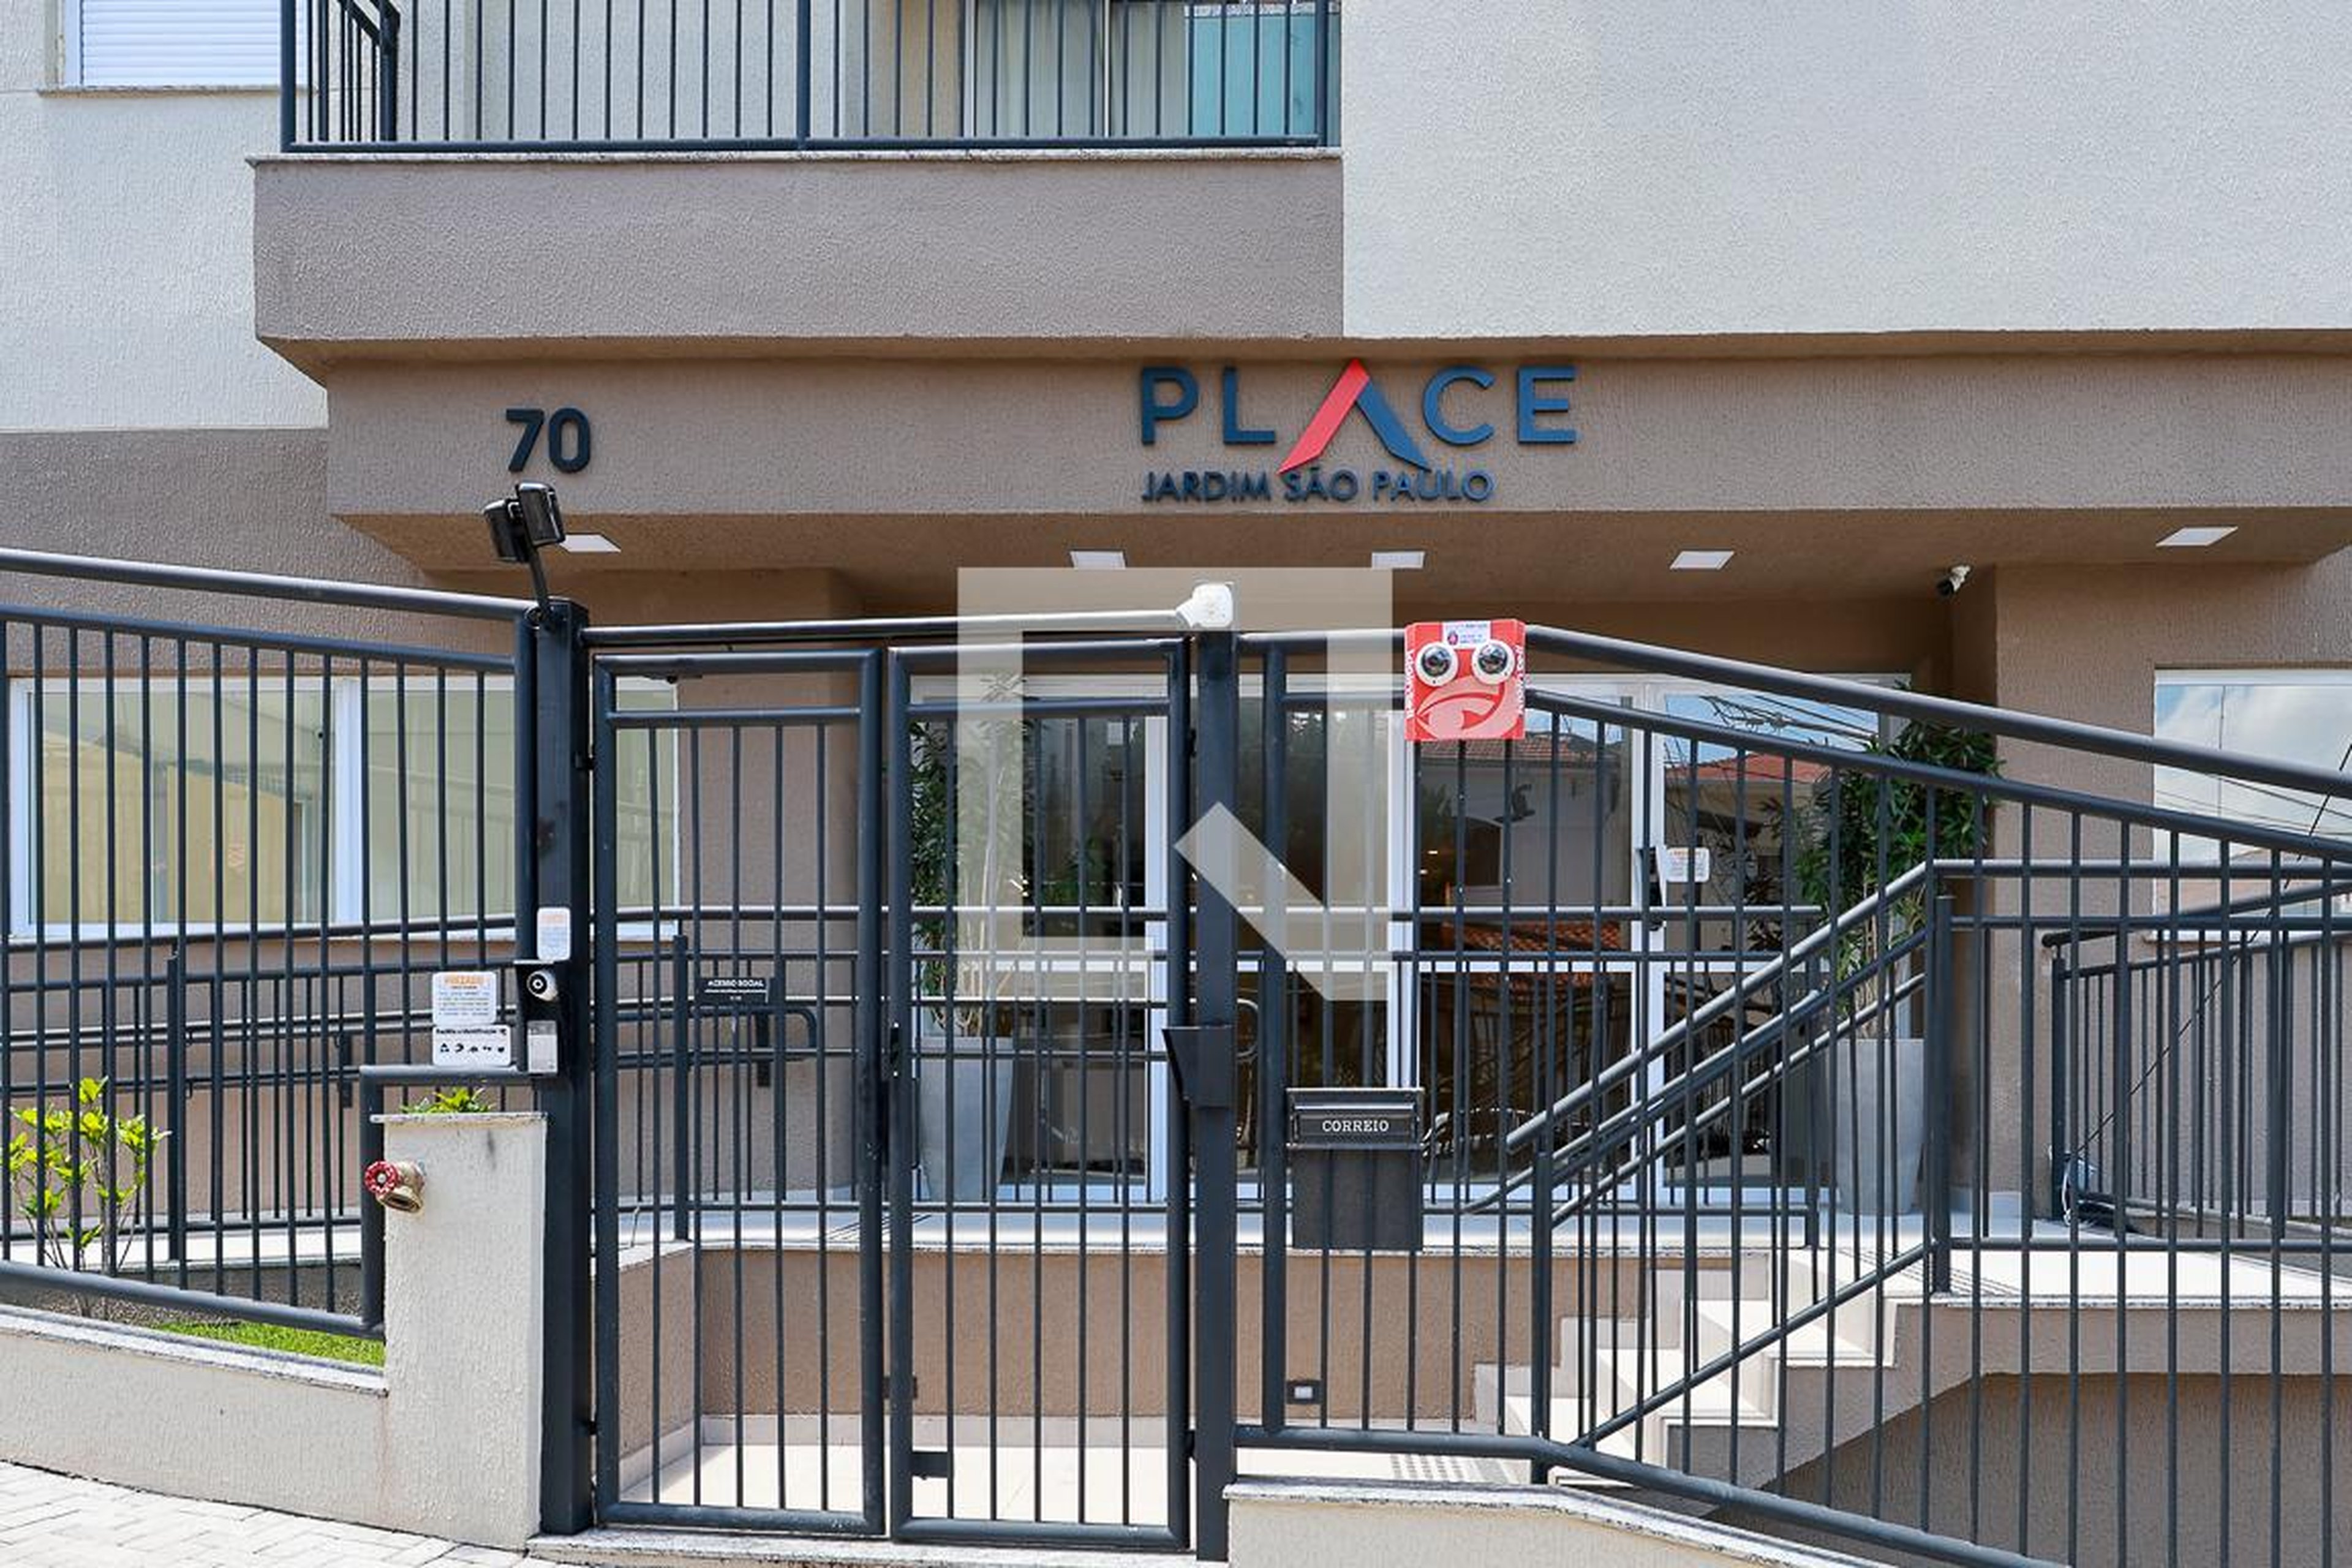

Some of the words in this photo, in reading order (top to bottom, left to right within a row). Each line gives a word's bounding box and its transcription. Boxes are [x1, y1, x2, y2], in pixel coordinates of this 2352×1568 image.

[1140, 358, 1578, 474] PLACE
[505, 407, 591, 474] 70
[1141, 471, 1272, 502] JARDIM
[1283, 466, 1360, 502] SÃO
[1371, 470, 1498, 502] PAULO
[737, 979, 764, 988] SOCIAL
[1322, 1119, 1390, 1133] CORREIO
